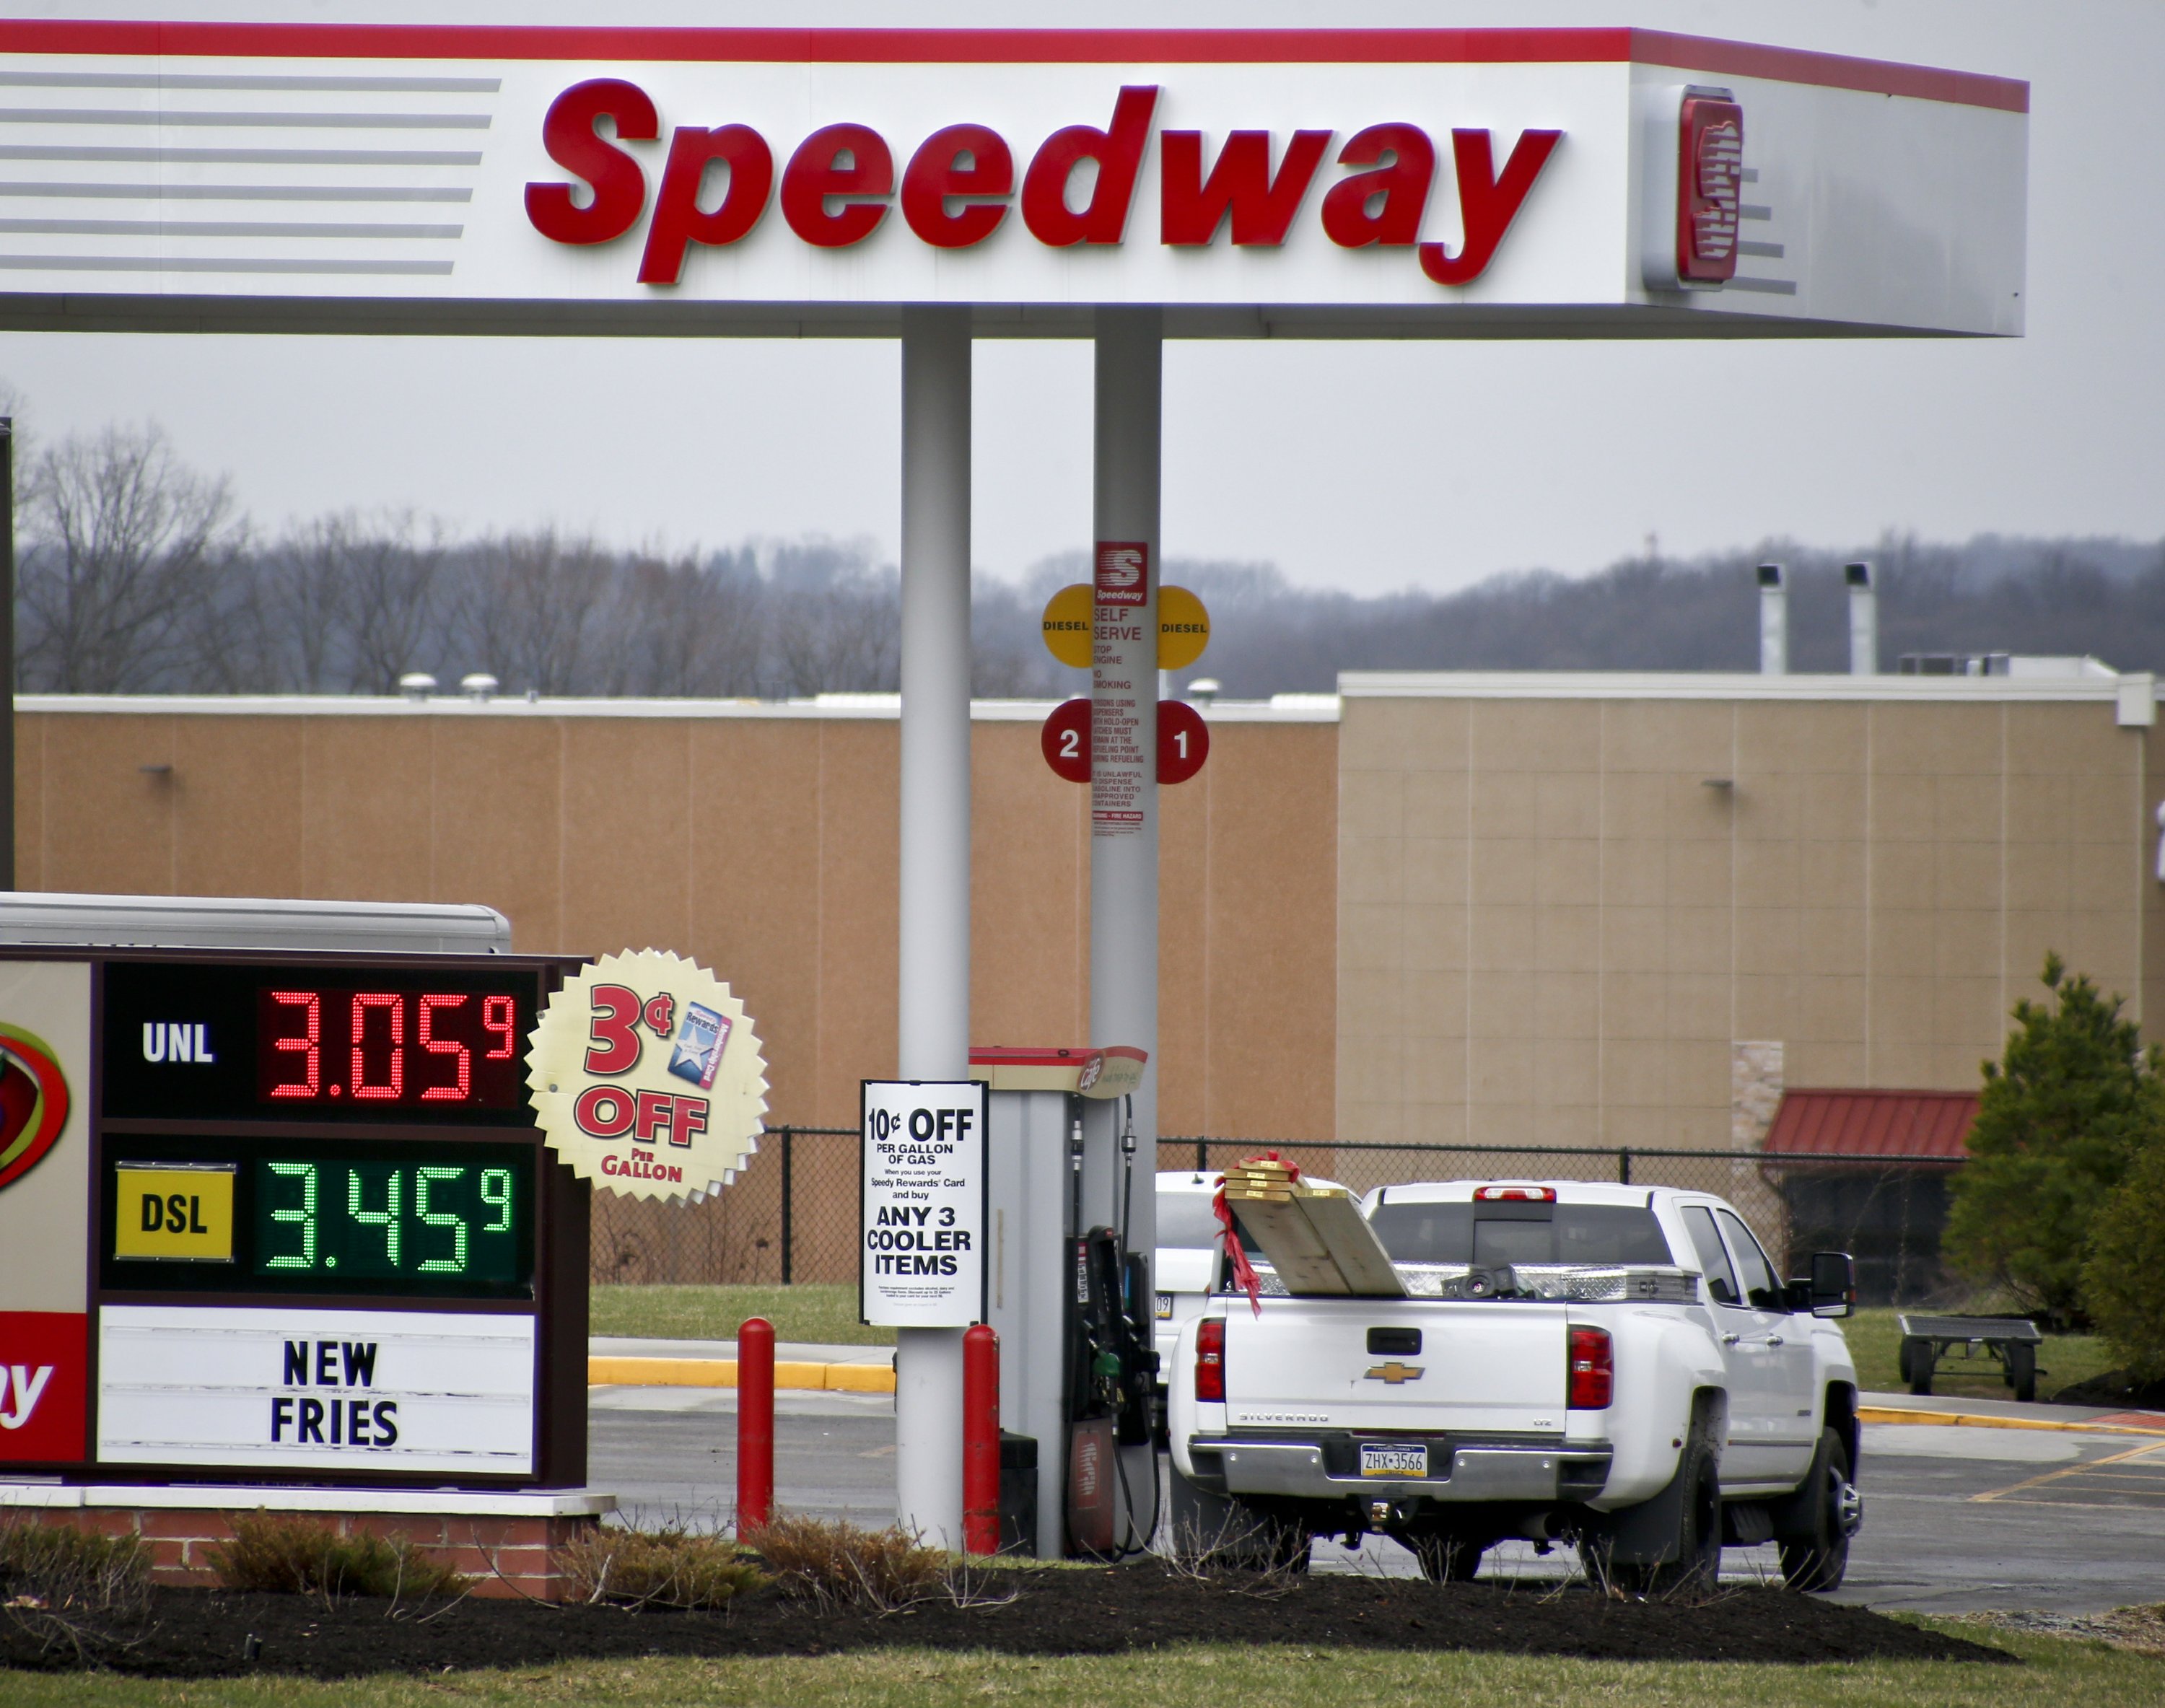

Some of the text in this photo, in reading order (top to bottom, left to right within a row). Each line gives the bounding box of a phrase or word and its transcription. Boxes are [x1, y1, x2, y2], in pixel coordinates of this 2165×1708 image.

[525, 79, 1565, 286] Speedway
[1097, 590, 1143, 601] Speedway
[1094, 608, 1129, 621] SELF
[1043, 621, 1088, 631] DIESEL
[1094, 626, 1142, 641] SERVE
[1162, 624, 1207, 633] DIESEL
[1116, 699, 1136, 708] USING
[1059, 730, 1079, 758] 2
[1173, 731, 1187, 758] 1
[686, 1012, 719, 1034] Rewards
[142, 1022, 214, 1063] UNL
[574, 1084, 709, 1149] OFF
[868, 1108, 974, 1142] 10¢ OFF
[877, 1144, 953, 1154] PER GALLON
[888, 1155, 936, 1165] OF GAS
[871, 1178, 894, 1188] Speedy
[943, 1178, 965, 1187] Card
[911, 1191, 930, 1201] buy
[141, 1194, 209, 1235] DSL
[877, 1206, 955, 1227] ANY 3
[867, 1230, 971, 1251] COOLER
[875, 1254, 958, 1276] ITEMS
[283, 1340, 377, 1388] NEW
[271, 1397, 398, 1447] FRIES
[1239, 1412, 1329, 1422] SILVERADO
